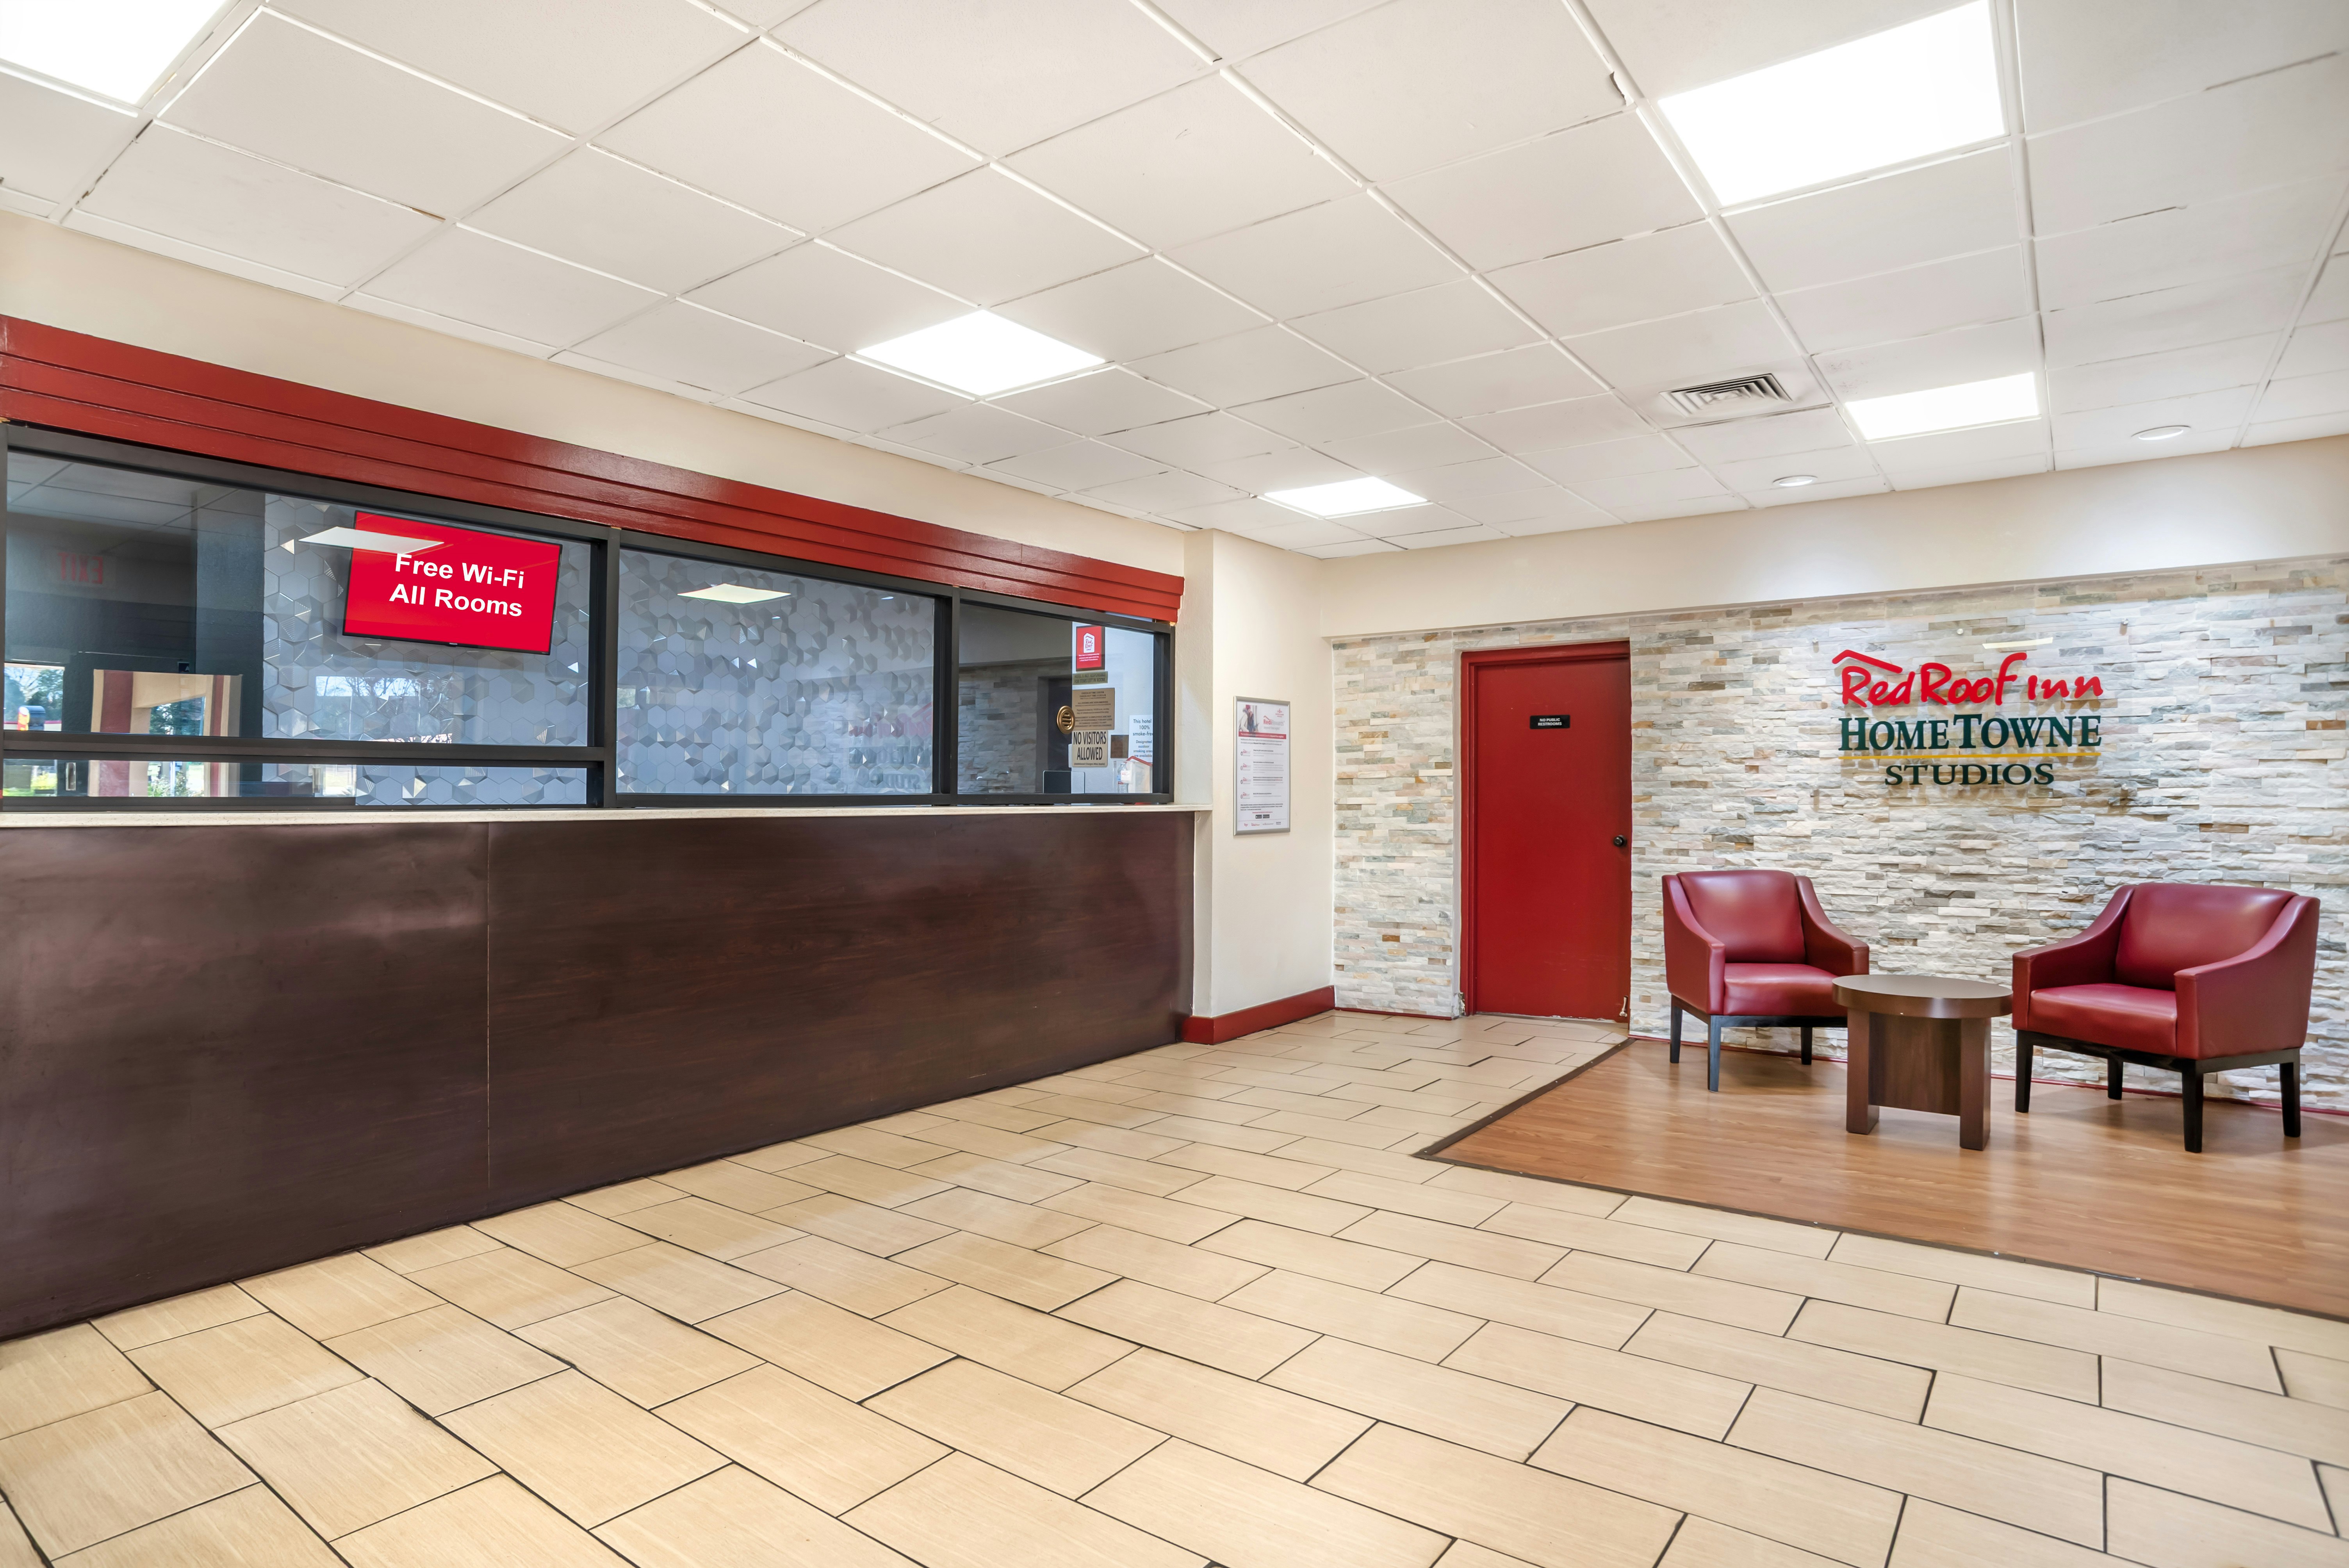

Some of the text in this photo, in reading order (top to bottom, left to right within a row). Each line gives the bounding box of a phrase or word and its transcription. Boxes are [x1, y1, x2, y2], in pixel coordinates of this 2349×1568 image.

[395, 553, 524, 589] Free Wi-Fi
[389, 583, 522, 617] All Rooms
[1841, 666, 1916, 707] Red
[1920, 652, 2027, 706] Roof
[1073, 731, 1107, 745] NO VISITORS
[1077, 747, 1103, 760] ALLOWED
[1885, 763, 2054, 786] STUDIOS
